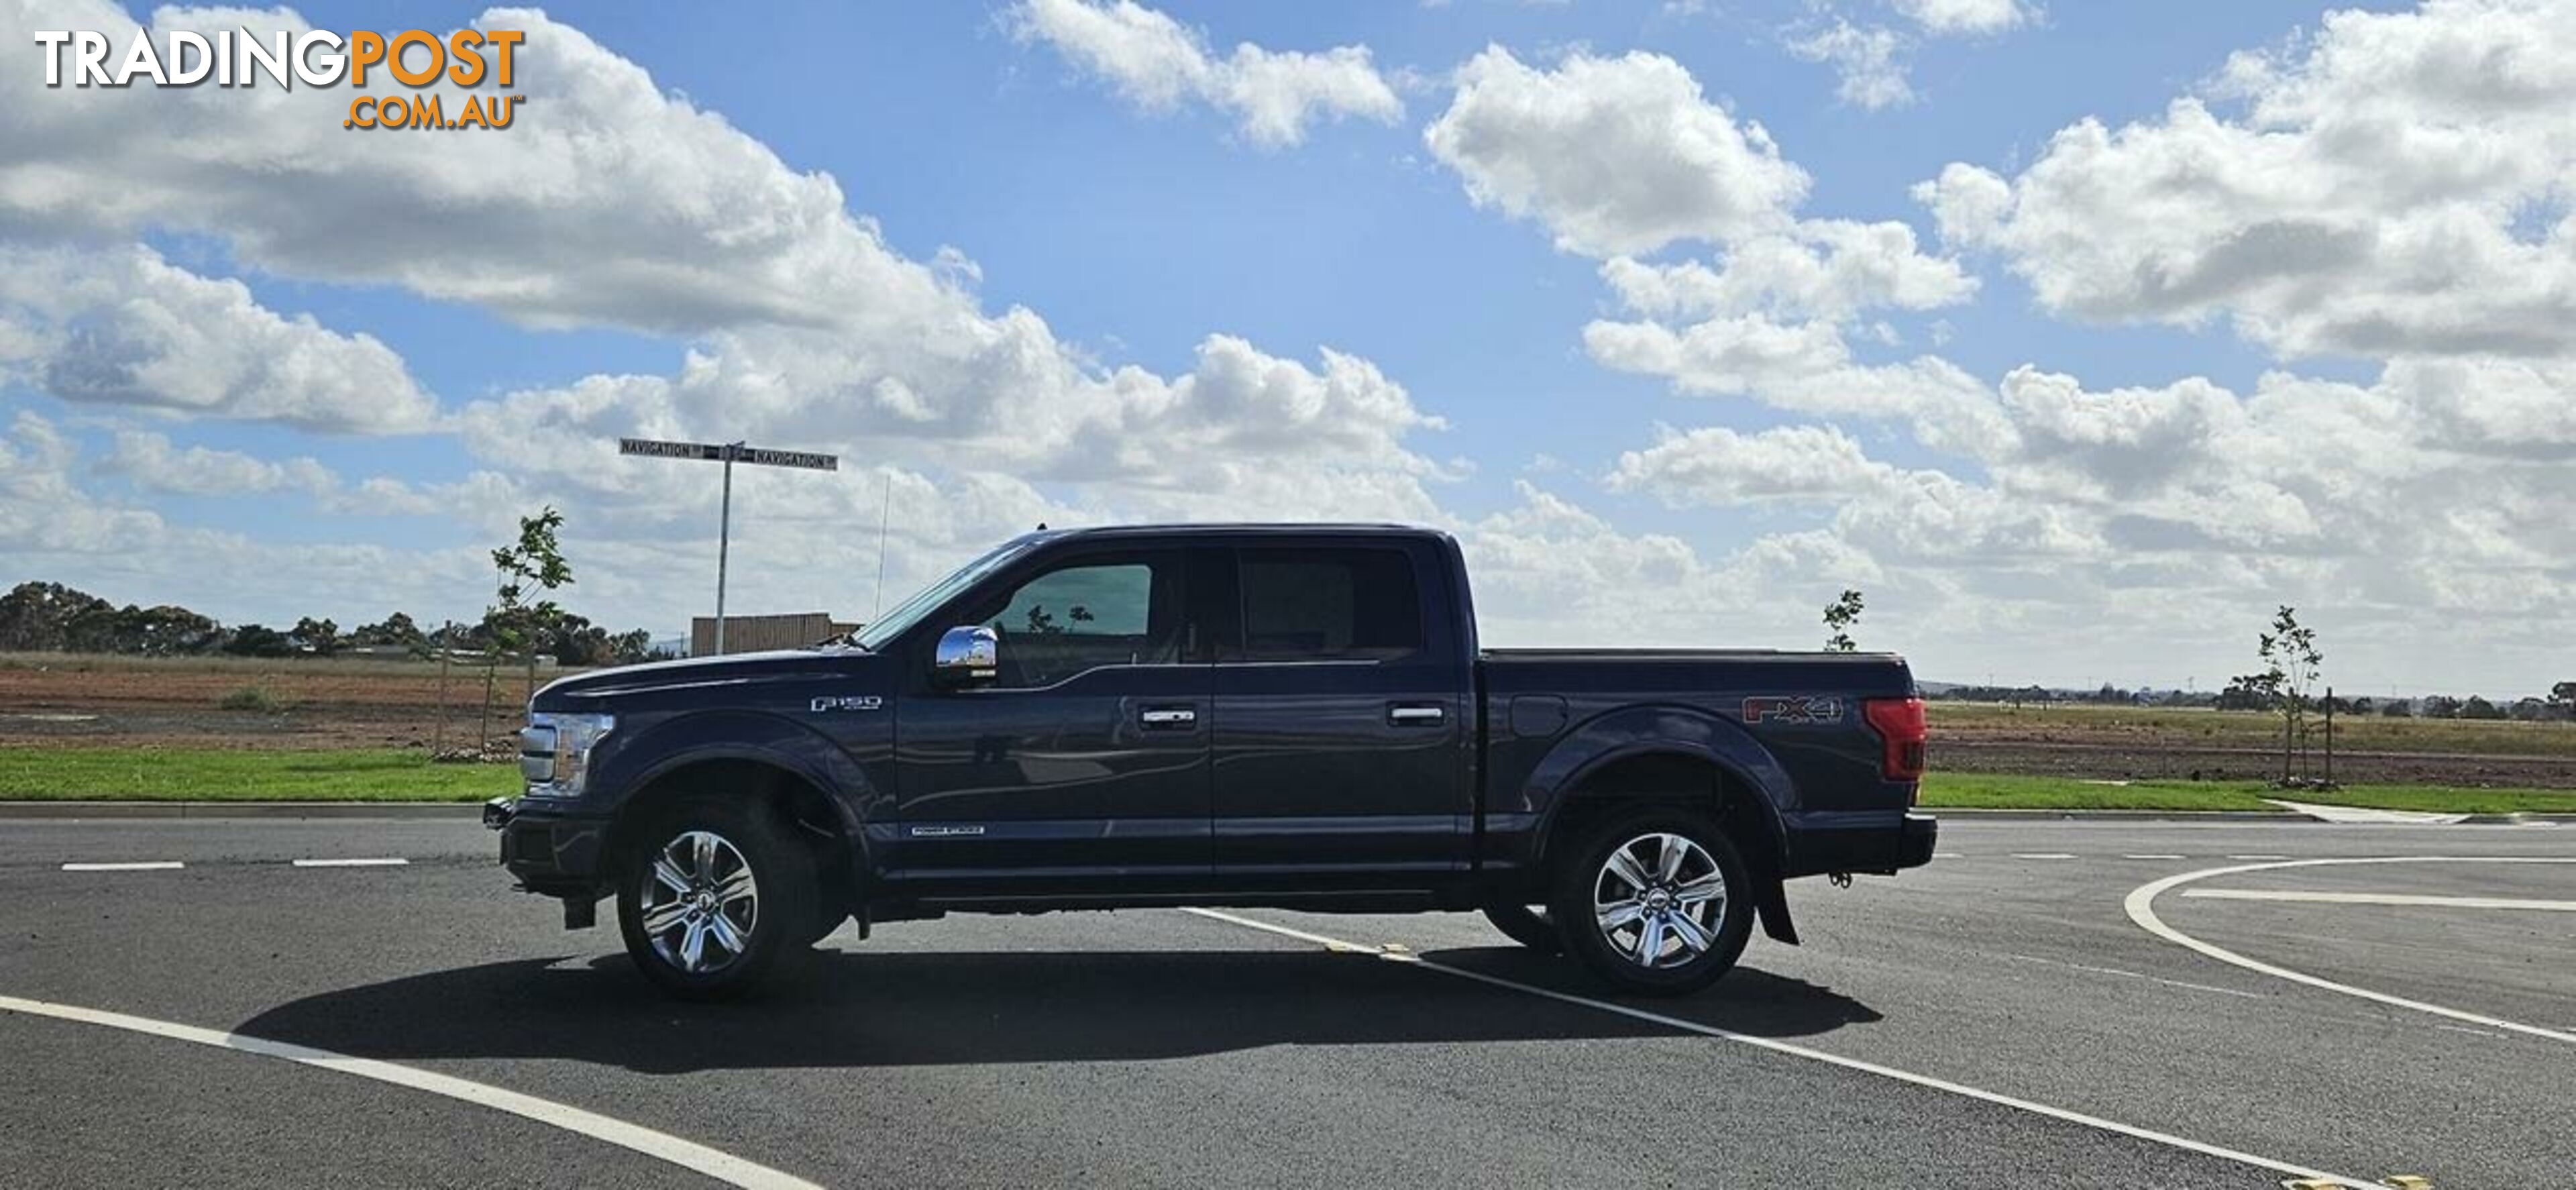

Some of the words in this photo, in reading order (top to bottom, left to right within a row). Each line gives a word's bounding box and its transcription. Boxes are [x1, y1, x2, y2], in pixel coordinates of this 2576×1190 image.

[620, 439, 690, 457] NAVIGATION
[755, 450, 824, 469] NAVIGATION
[1742, 696, 1843, 723] FX4
